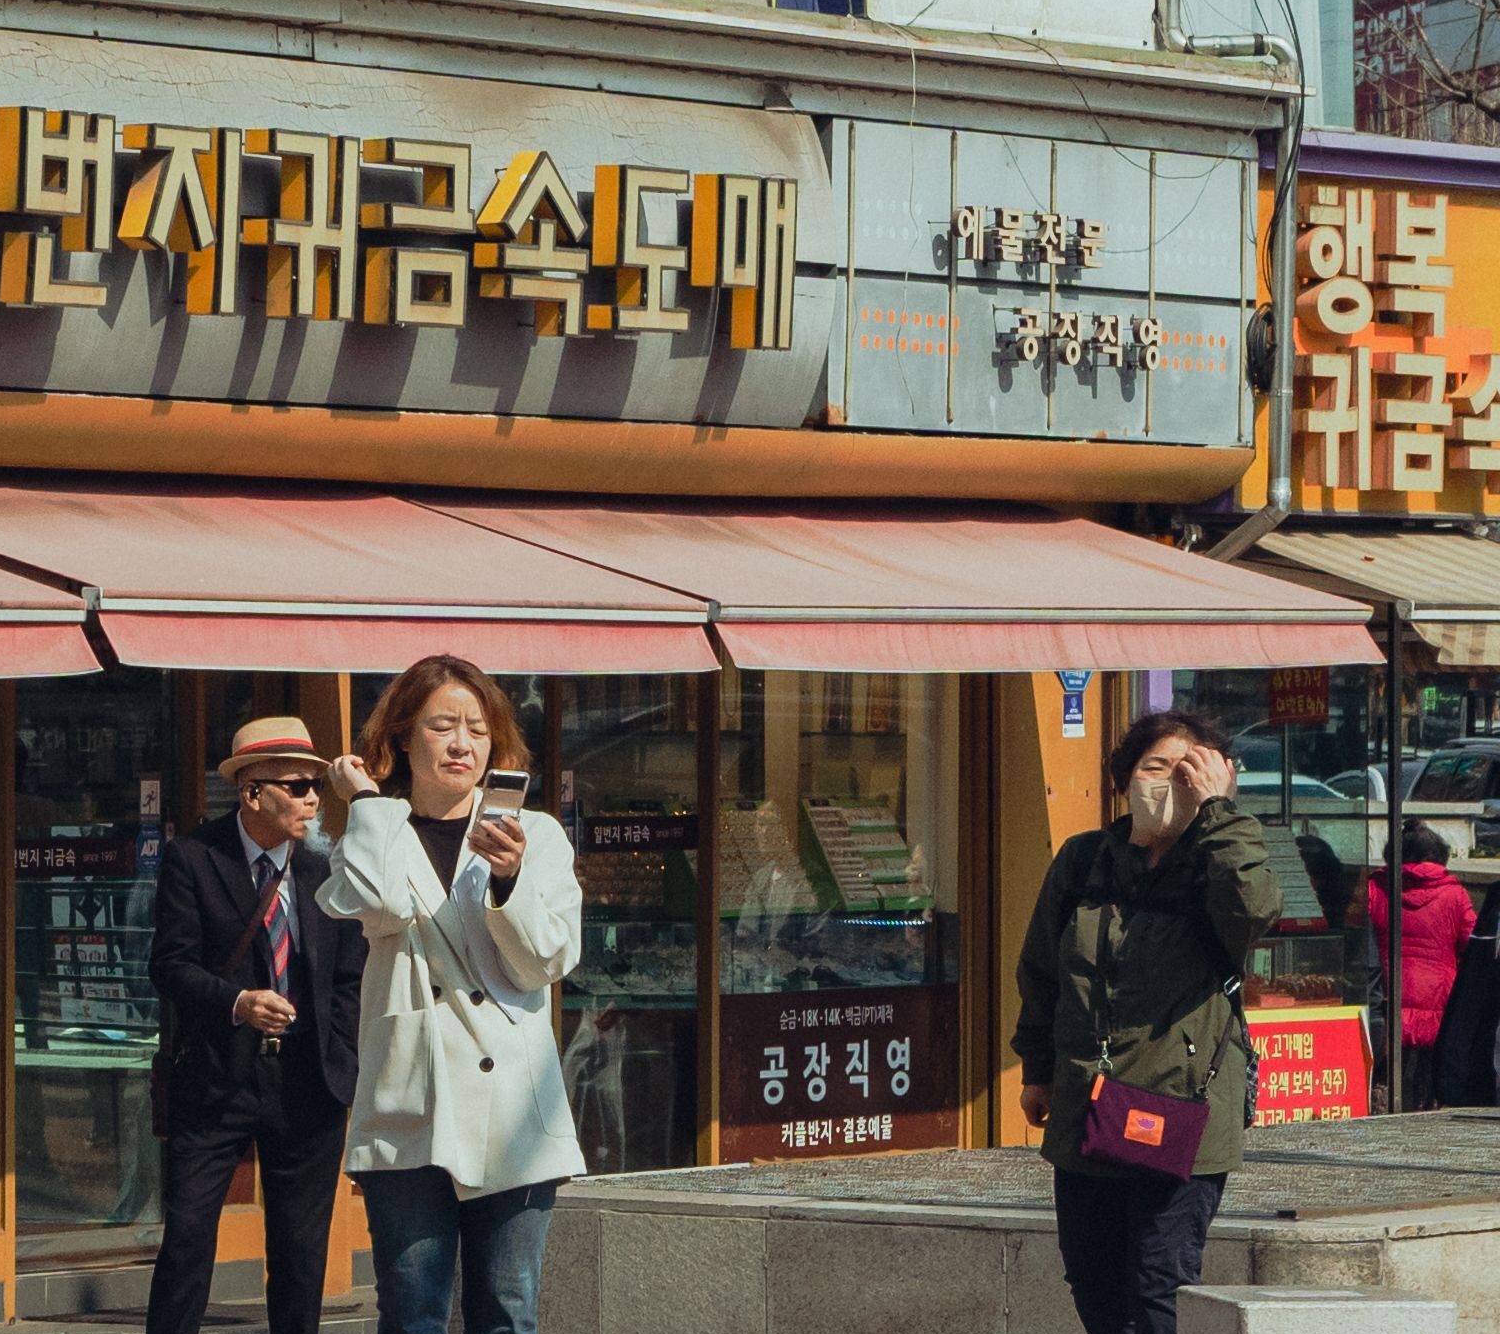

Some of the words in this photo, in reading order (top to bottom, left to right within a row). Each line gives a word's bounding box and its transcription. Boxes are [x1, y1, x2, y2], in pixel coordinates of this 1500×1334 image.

[950, 203, 1107, 269] 예물전문
[1300, 185, 1455, 338] 행복
[1015, 305, 1164, 372] 공장직영
[43, 847, 77, 868] 귀금속
[140, 839, 160, 858] ADT
[758, 1036, 912, 1107] 공장직영
[1271, 1032, 1314, 1060] 고가매입
